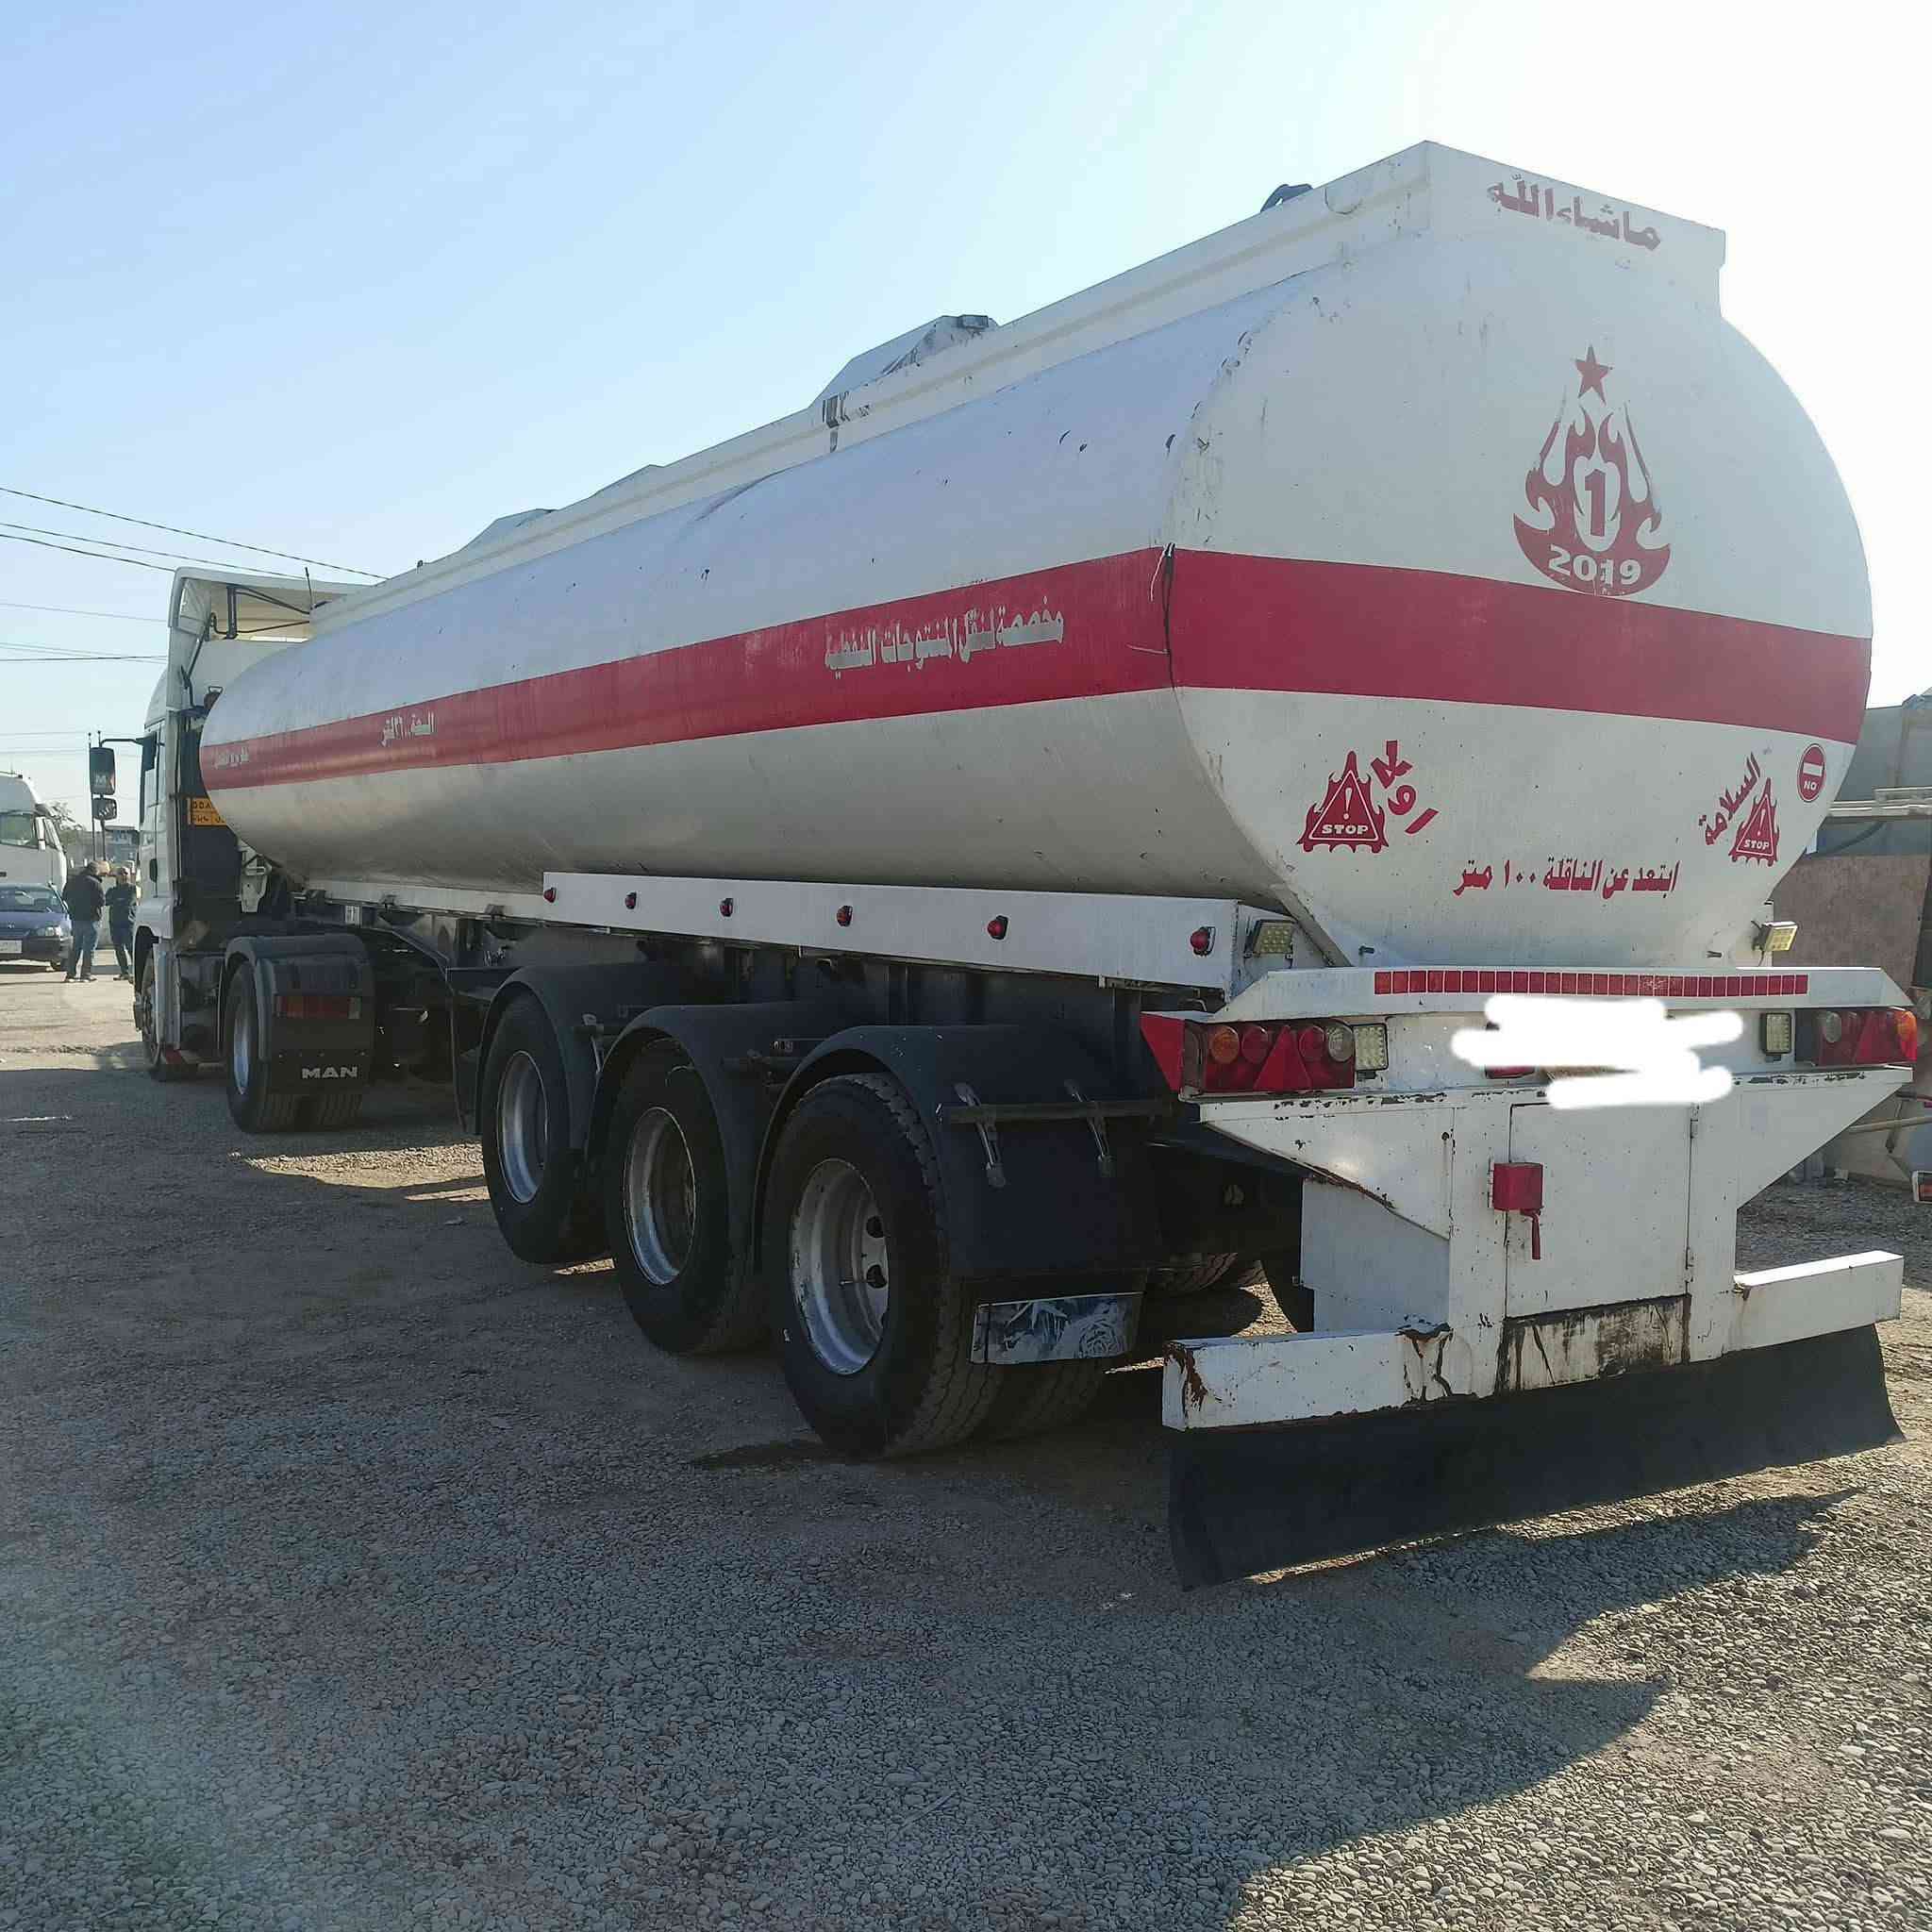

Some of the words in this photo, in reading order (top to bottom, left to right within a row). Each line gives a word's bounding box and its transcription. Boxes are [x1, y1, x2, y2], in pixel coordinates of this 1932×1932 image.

[1584, 468, 1606, 538] 1
[1548, 543, 1642, 588] 2019
[1699, 752, 1761, 846] السلامة
[1803, 779, 1818, 791] NO
[1321, 824, 1369, 835] STOP
[1744, 839, 1771, 851] STOP
[1453, 859, 1493, 897] متر
[1542, 856, 1603, 892] الناقلة
[1602, 867, 1630, 900] عن
[1632, 859, 1682, 899] ابتعد
[301, 1066, 358, 1079] MAN
